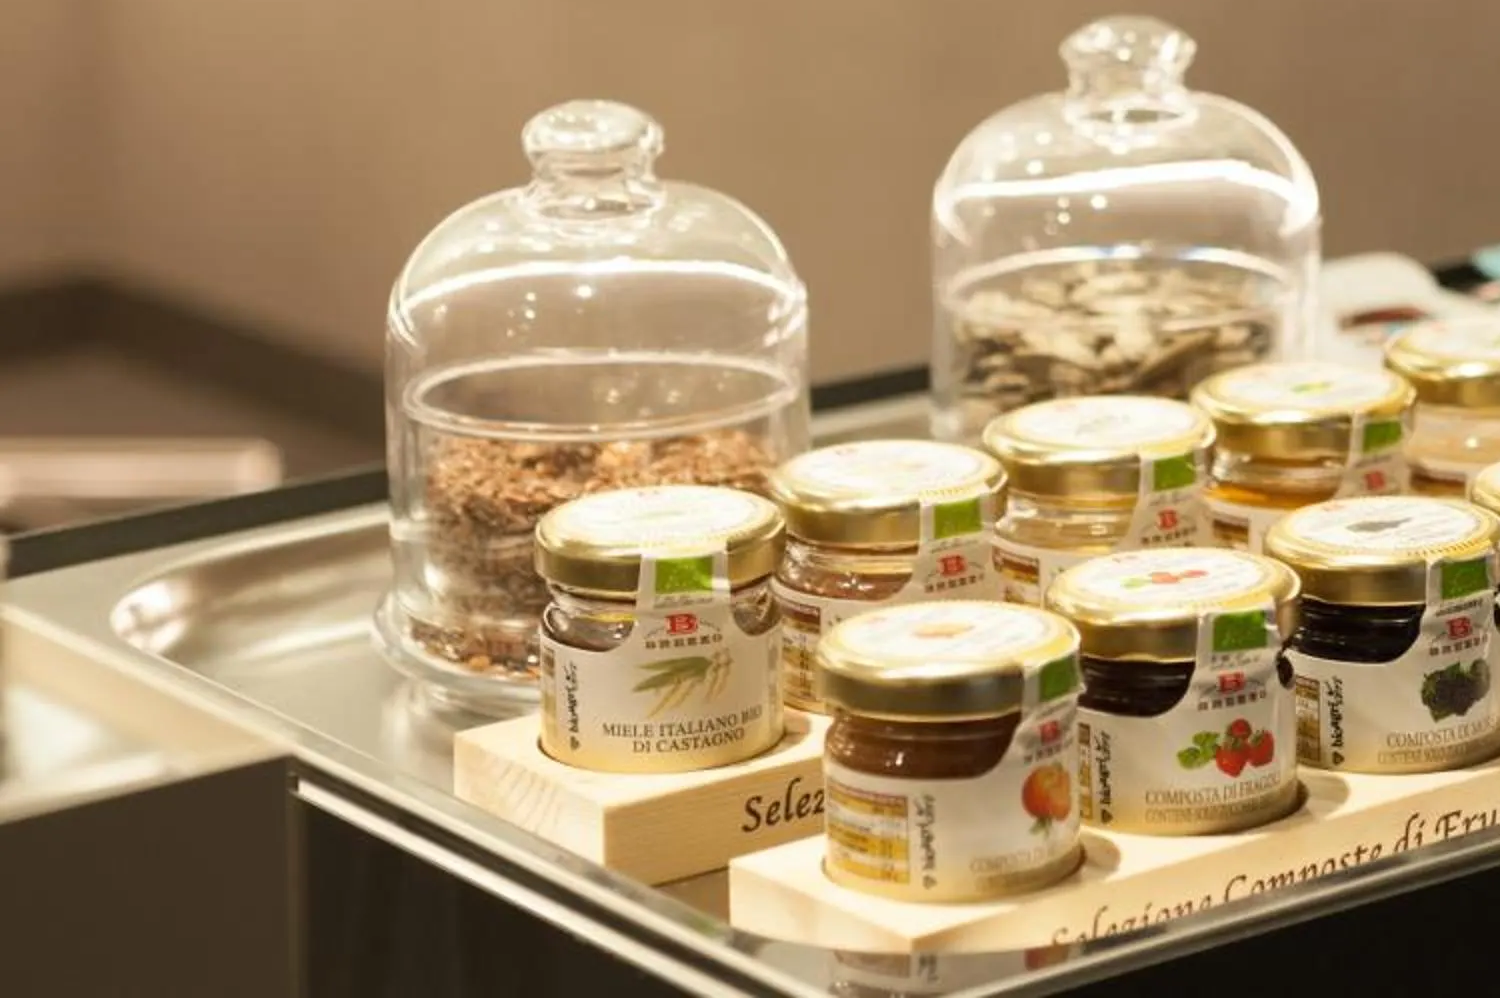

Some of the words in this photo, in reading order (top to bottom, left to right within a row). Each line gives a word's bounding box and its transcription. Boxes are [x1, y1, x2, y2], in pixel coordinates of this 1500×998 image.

[665, 613, 698, 635] B
[602, 722, 654, 739] MIELE
[658, 713, 738, 738] ITALIANO
[741, 704, 763, 724] BIO
[633, 738, 651, 753] DI
[656, 727, 745, 753] CASTAGNO
[1386, 729, 1456, 748] COMPOSTA
[741, 775, 825, 833] Selez
[1145, 785, 1220, 805] COMPOSTA
[1394, 812, 1425, 852] di
